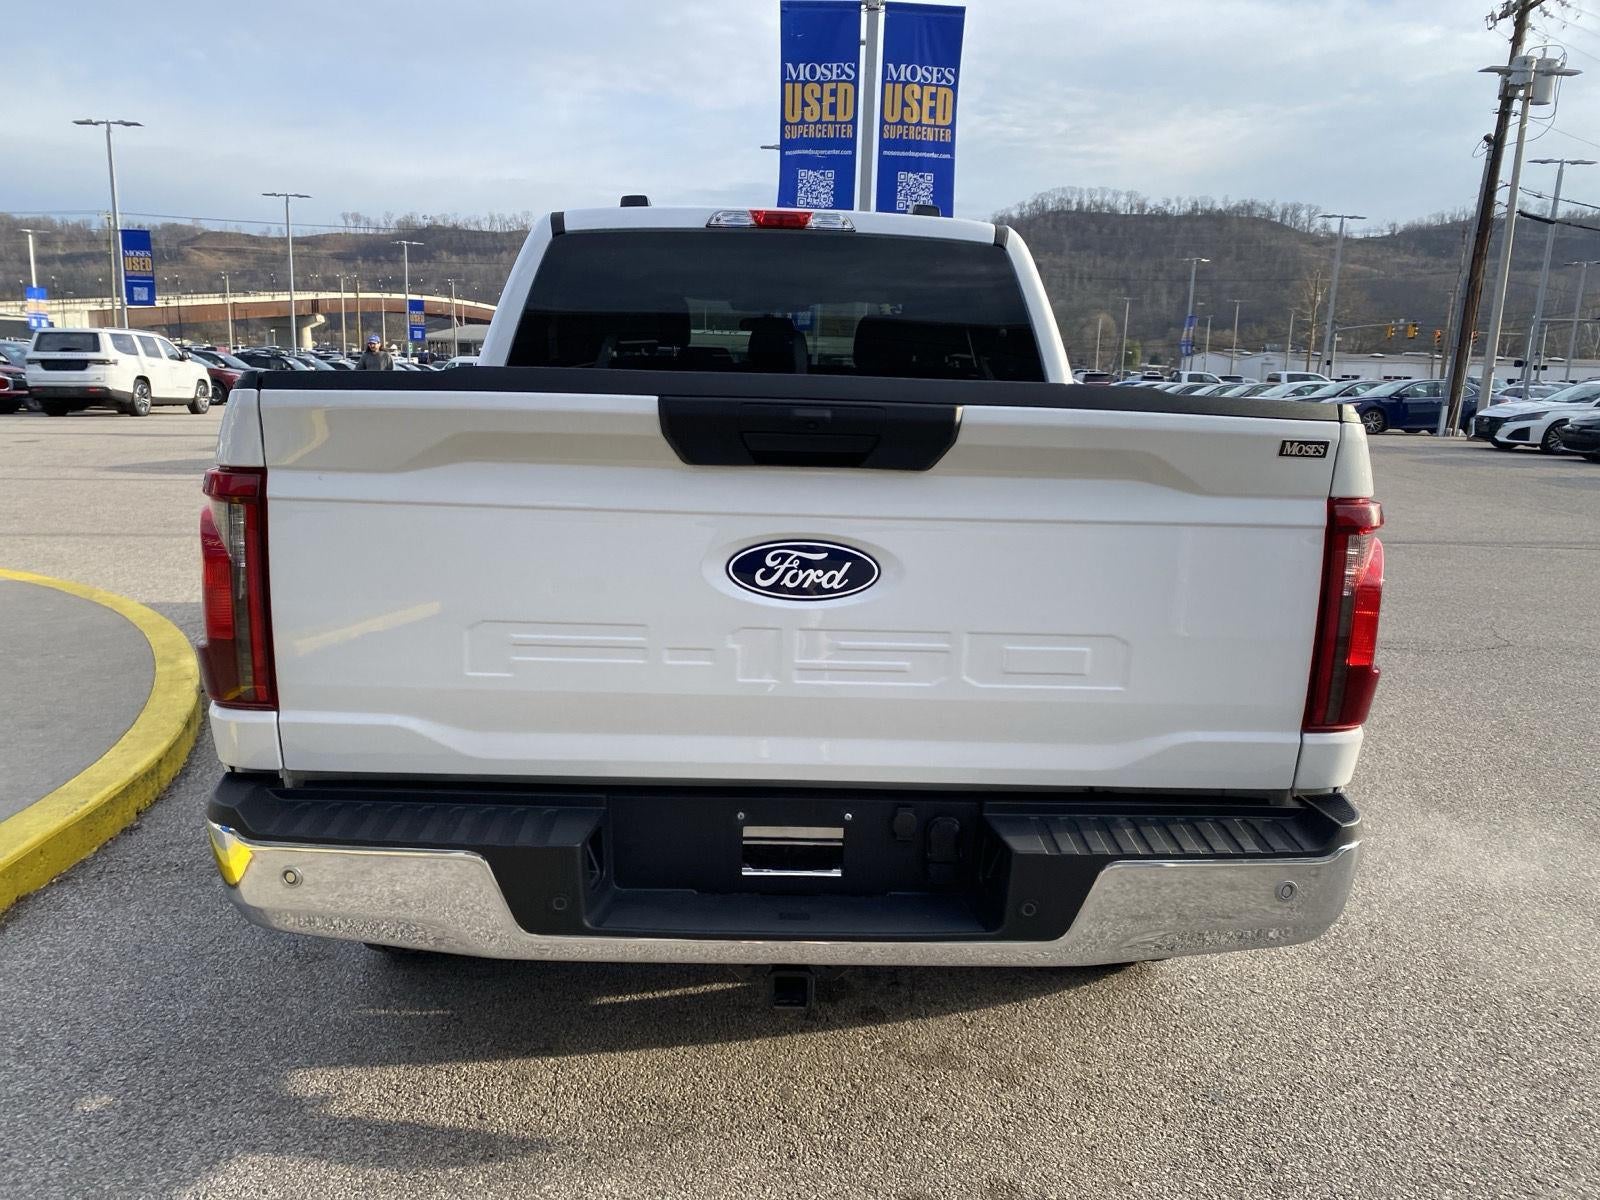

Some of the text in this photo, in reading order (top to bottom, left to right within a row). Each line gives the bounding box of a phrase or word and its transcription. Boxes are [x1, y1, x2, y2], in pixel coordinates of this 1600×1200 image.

[785, 62, 855, 81] MOSES
[886, 63, 955, 85] MOSES
[784, 82, 855, 123] USED
[883, 83, 954, 126] USED
[784, 124, 853, 140] SUPERCENTER
[883, 125, 952, 142] SUPERCENTER
[124, 249, 152, 257] MOSES
[124, 257, 153, 271] USED
[1282, 441, 1325, 456] MOSES
[755, 549, 852, 590] Ford
[464, 619, 1133, 691] F-150
